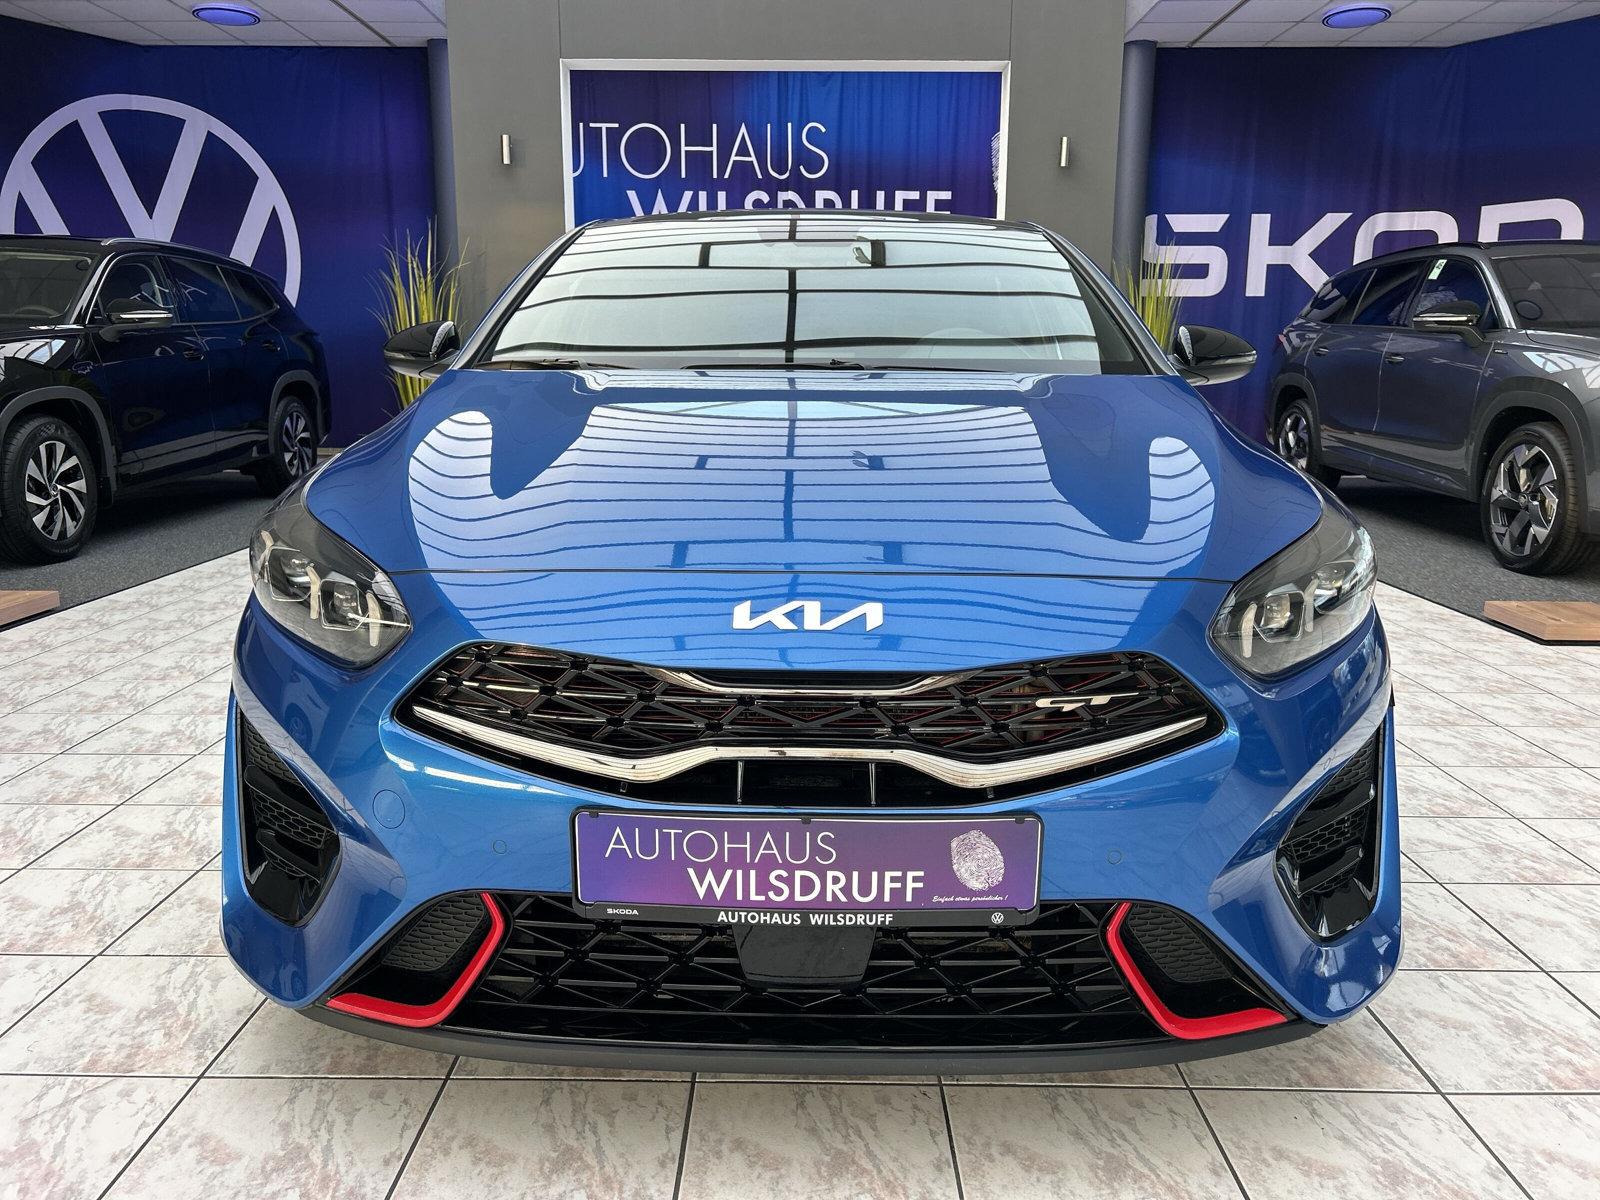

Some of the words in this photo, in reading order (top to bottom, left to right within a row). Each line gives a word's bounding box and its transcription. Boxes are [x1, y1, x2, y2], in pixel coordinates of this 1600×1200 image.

[1036, 692, 1139, 712] GT
[605, 826, 837, 865] AUTOHAUS
[687, 867, 925, 902] WILSDRUFF
[717, 911, 801, 926] AUTOHAUS
[809, 912, 894, 926] WILSDRUFF
